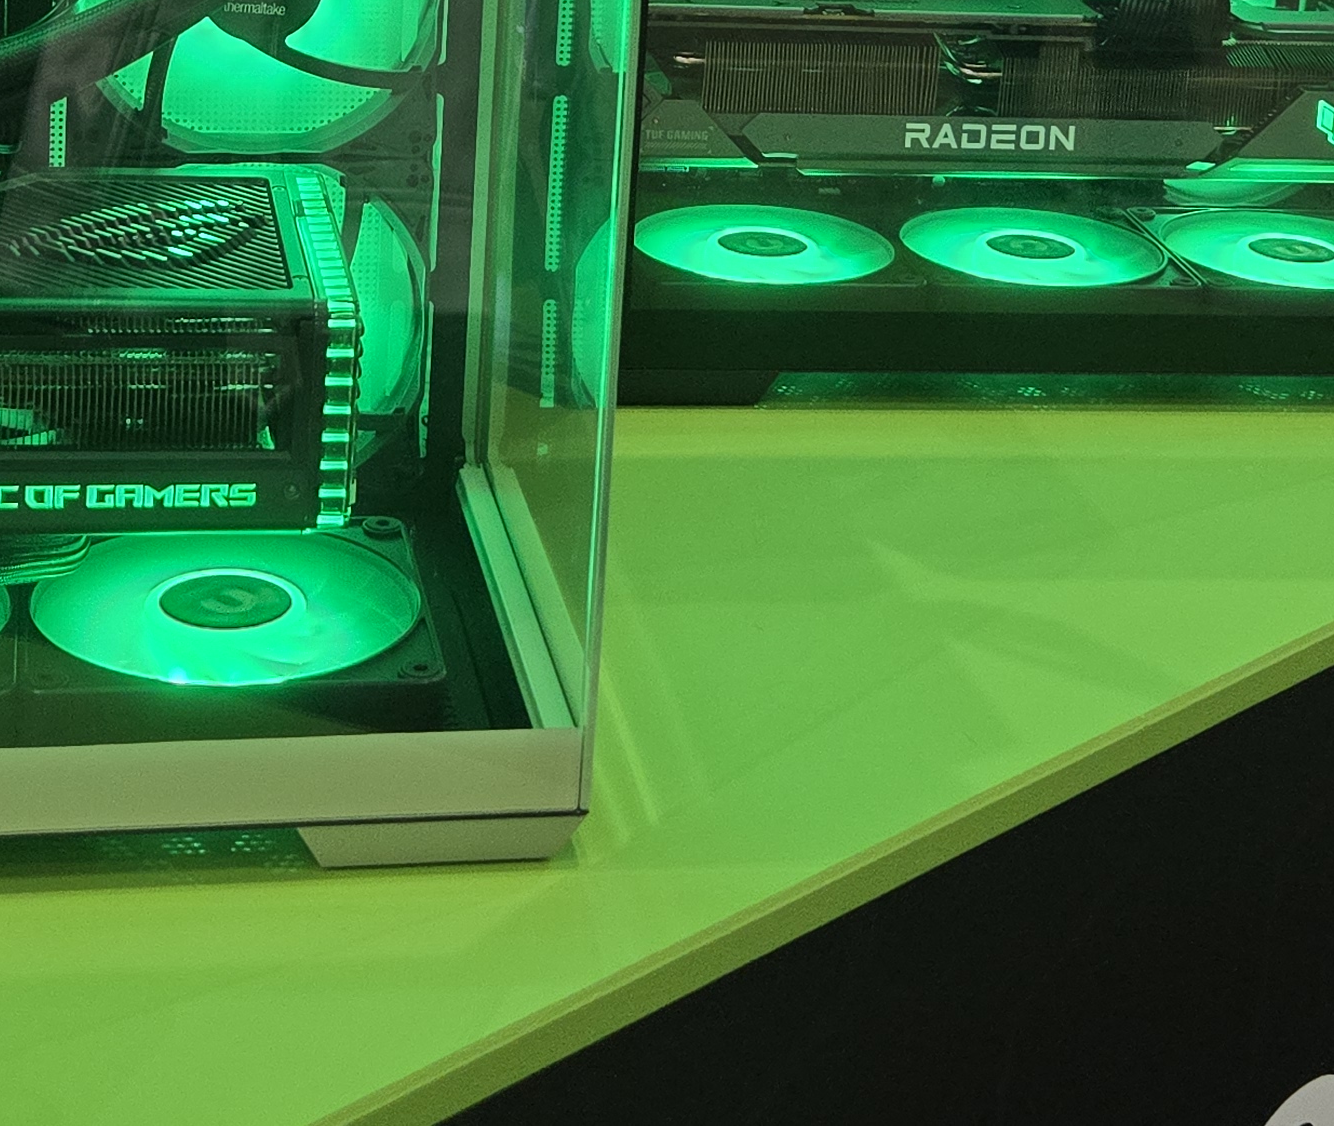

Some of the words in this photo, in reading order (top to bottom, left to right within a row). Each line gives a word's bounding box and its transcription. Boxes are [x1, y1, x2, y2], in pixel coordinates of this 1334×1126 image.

[904, 123, 1076, 151] RADEON
[24, 484, 81, 509] OF
[85, 483, 257, 508] GAMERS
